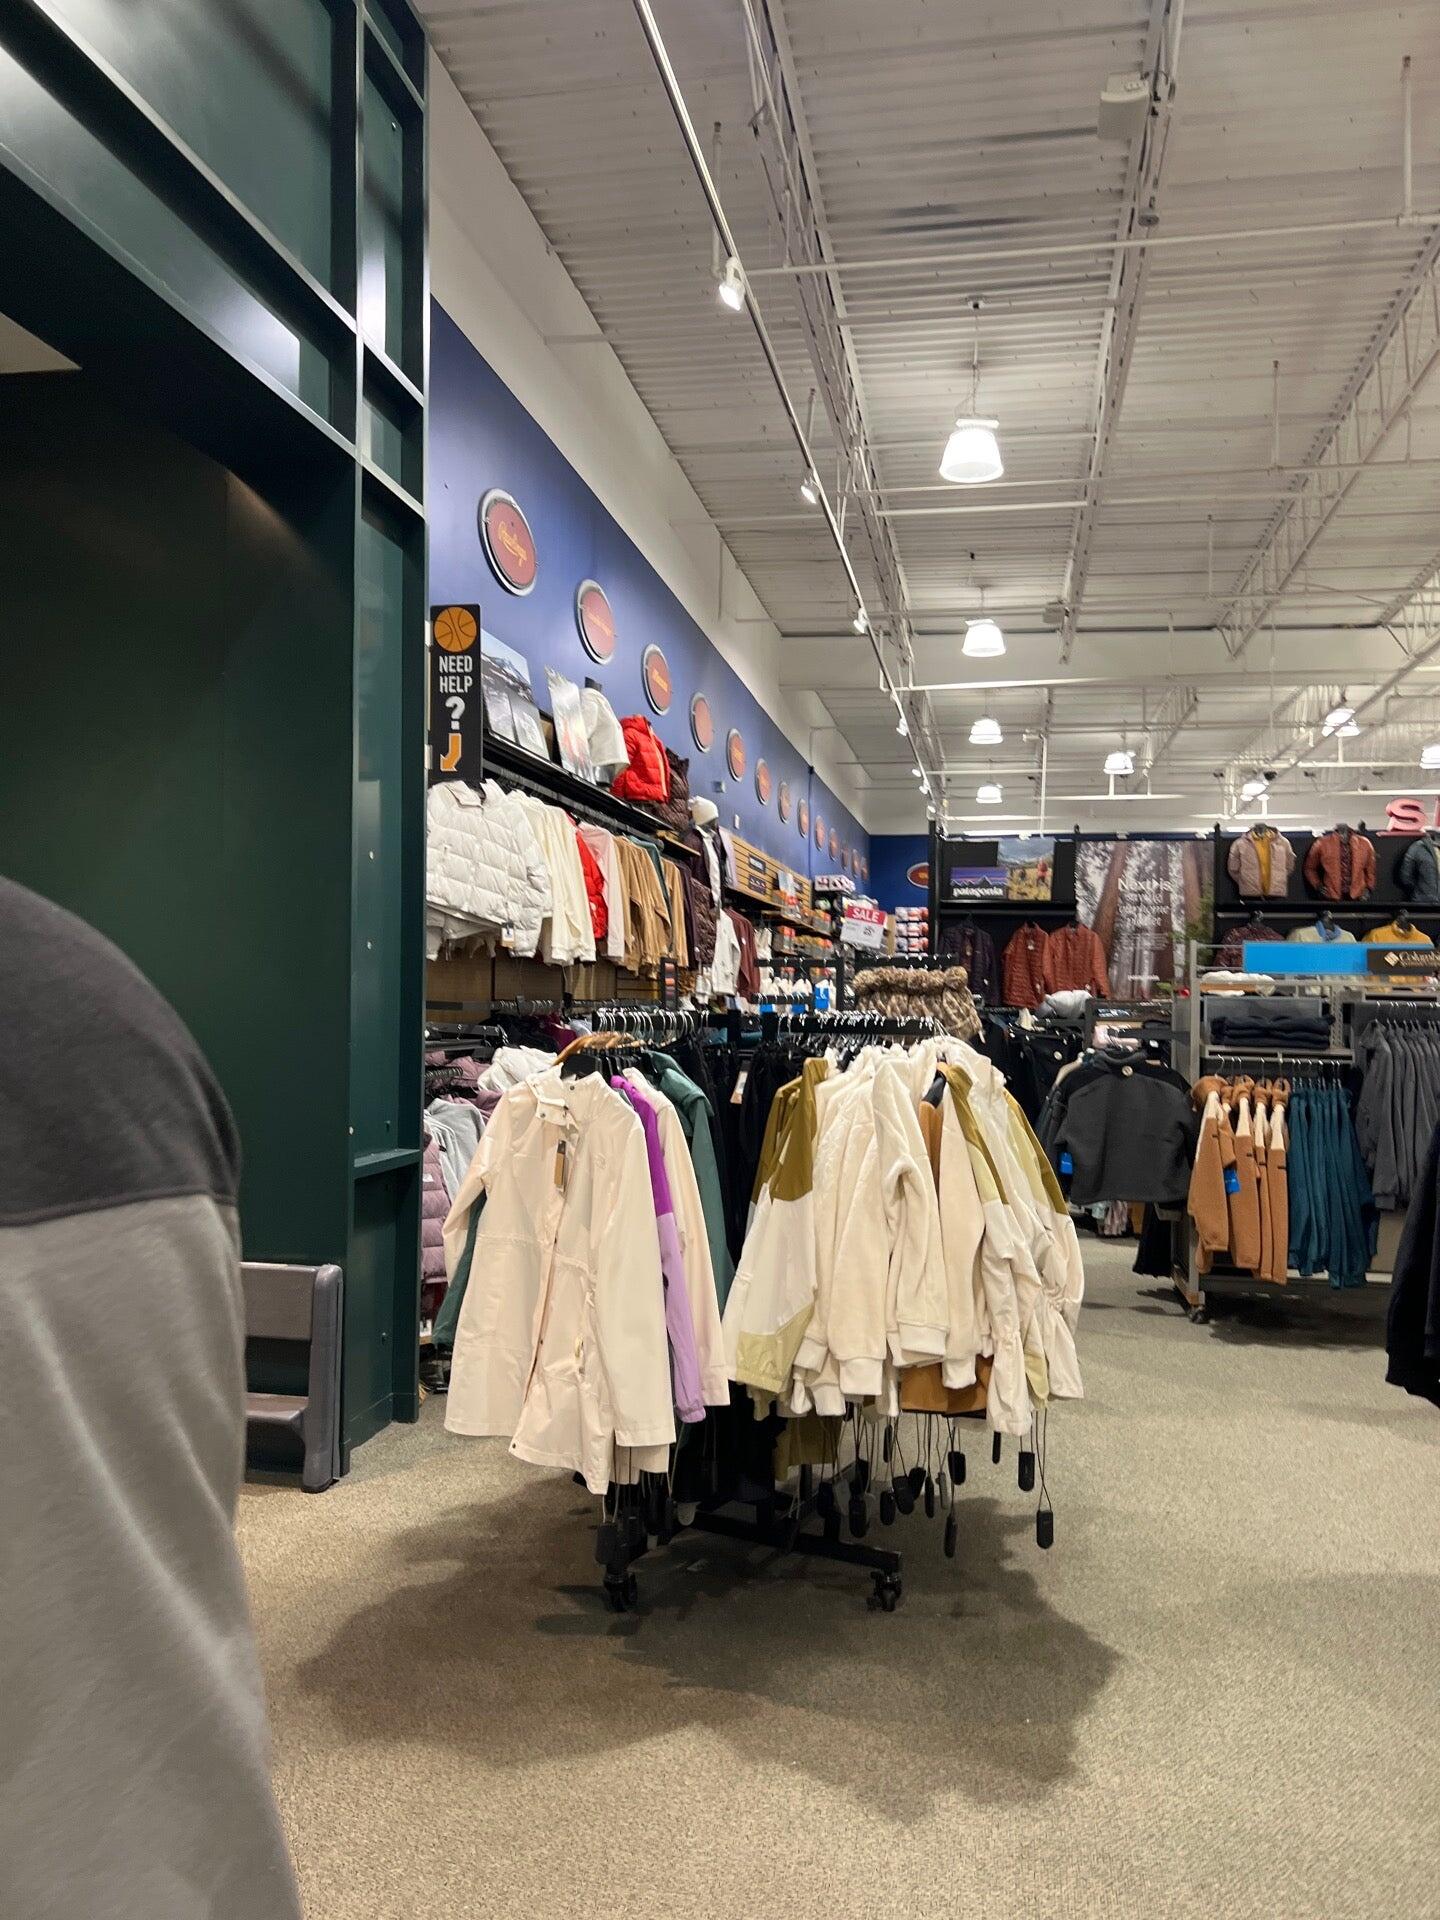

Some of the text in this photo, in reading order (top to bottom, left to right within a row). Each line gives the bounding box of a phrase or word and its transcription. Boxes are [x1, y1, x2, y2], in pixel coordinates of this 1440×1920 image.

[439, 655, 473, 673] NEED
[439, 675, 473, 693] HELP
[445, 695, 466, 730] ?
[851, 908, 880, 923] SALE
